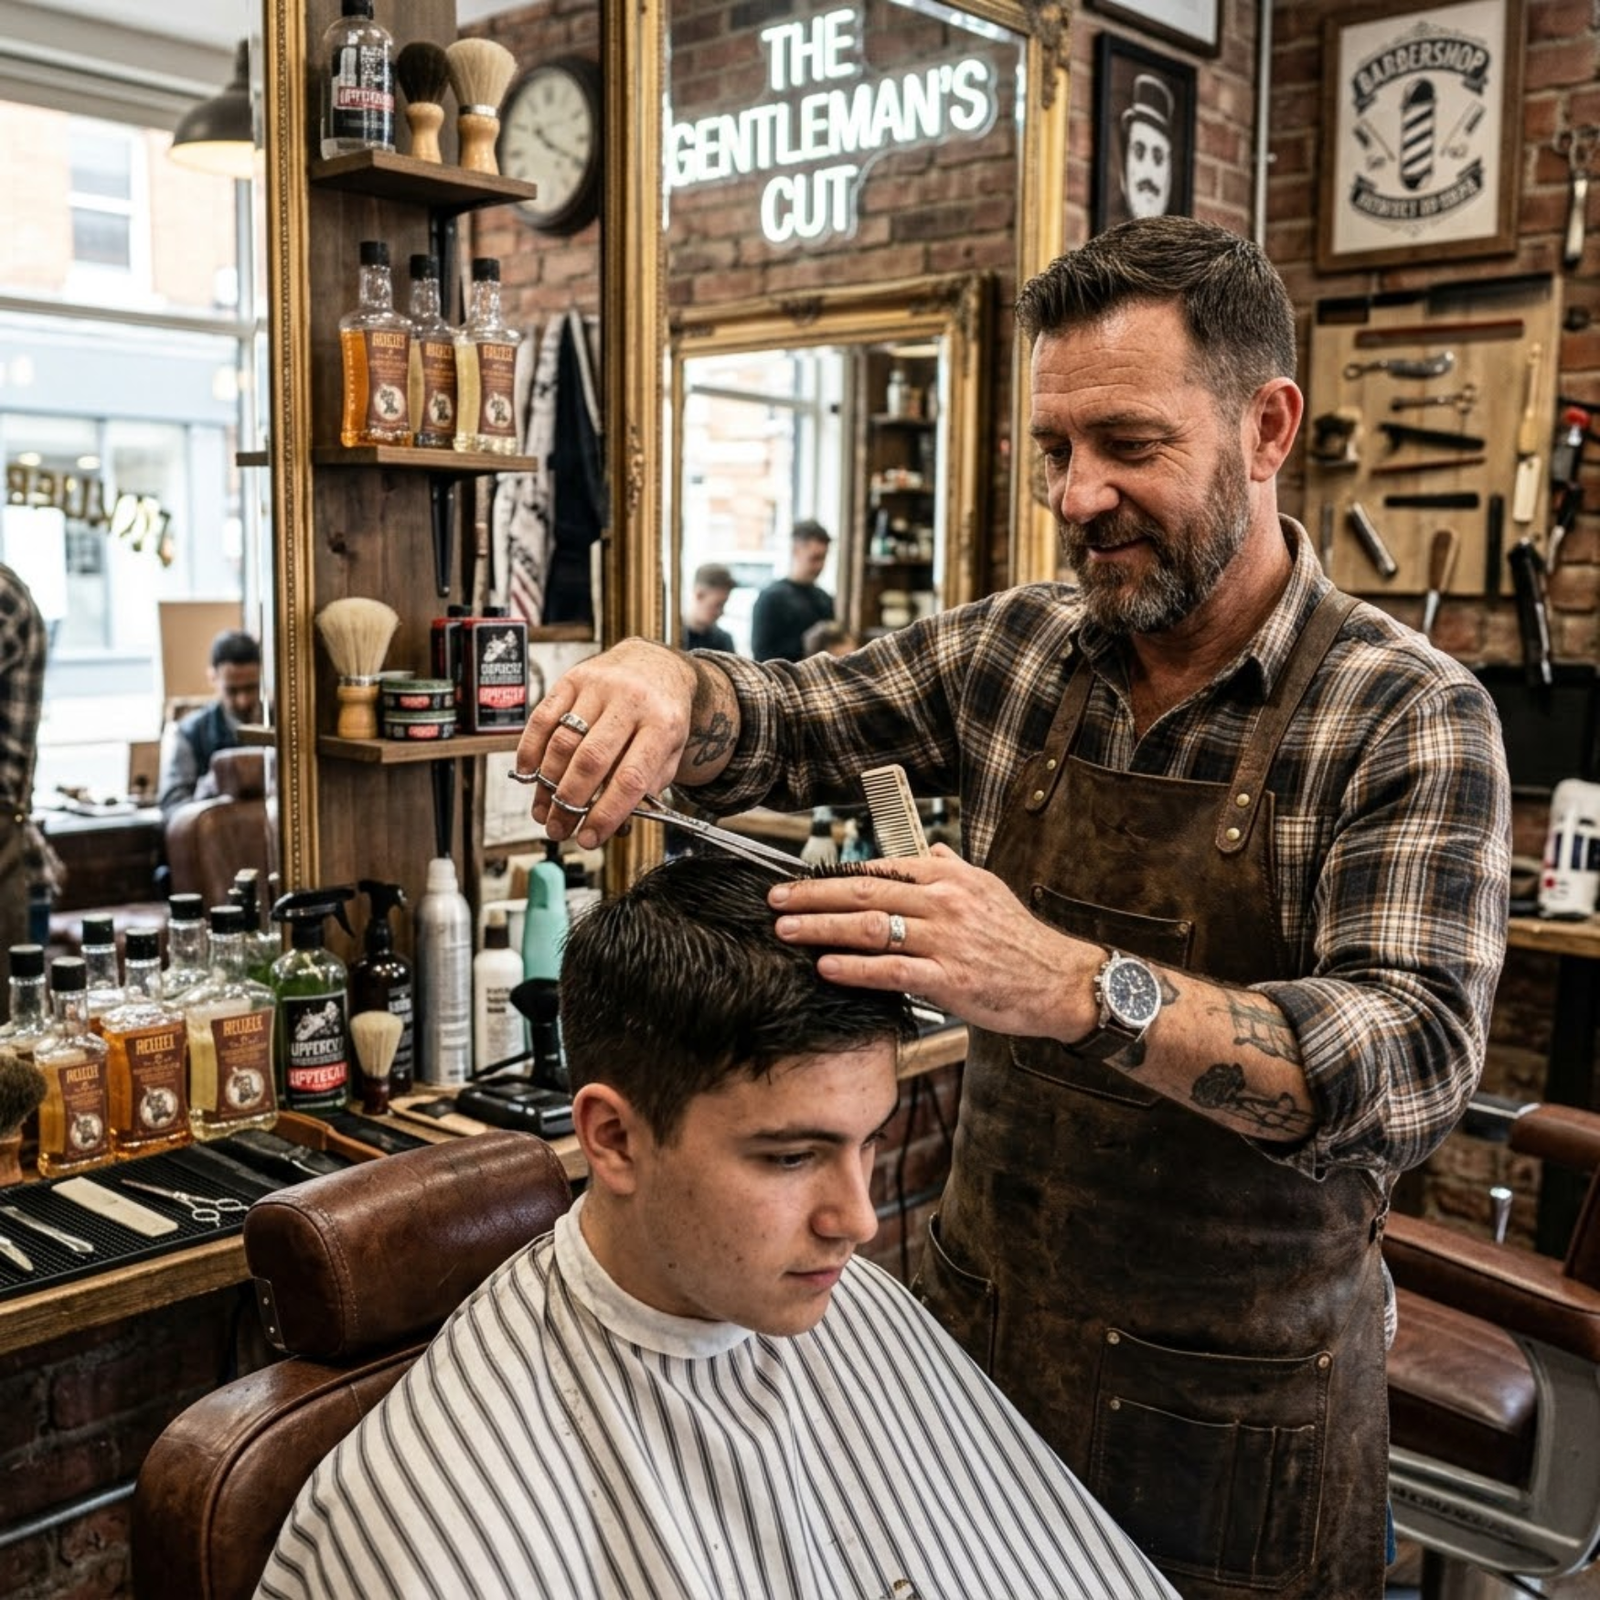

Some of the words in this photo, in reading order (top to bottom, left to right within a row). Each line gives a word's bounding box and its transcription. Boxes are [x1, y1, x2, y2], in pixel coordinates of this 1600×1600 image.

[761, 9, 857, 91] THE
[1356, 41, 1487, 96] BARBERSHOP
[667, 59, 989, 188] GENTLEMAN'S
[760, 164, 858, 243] CUT
